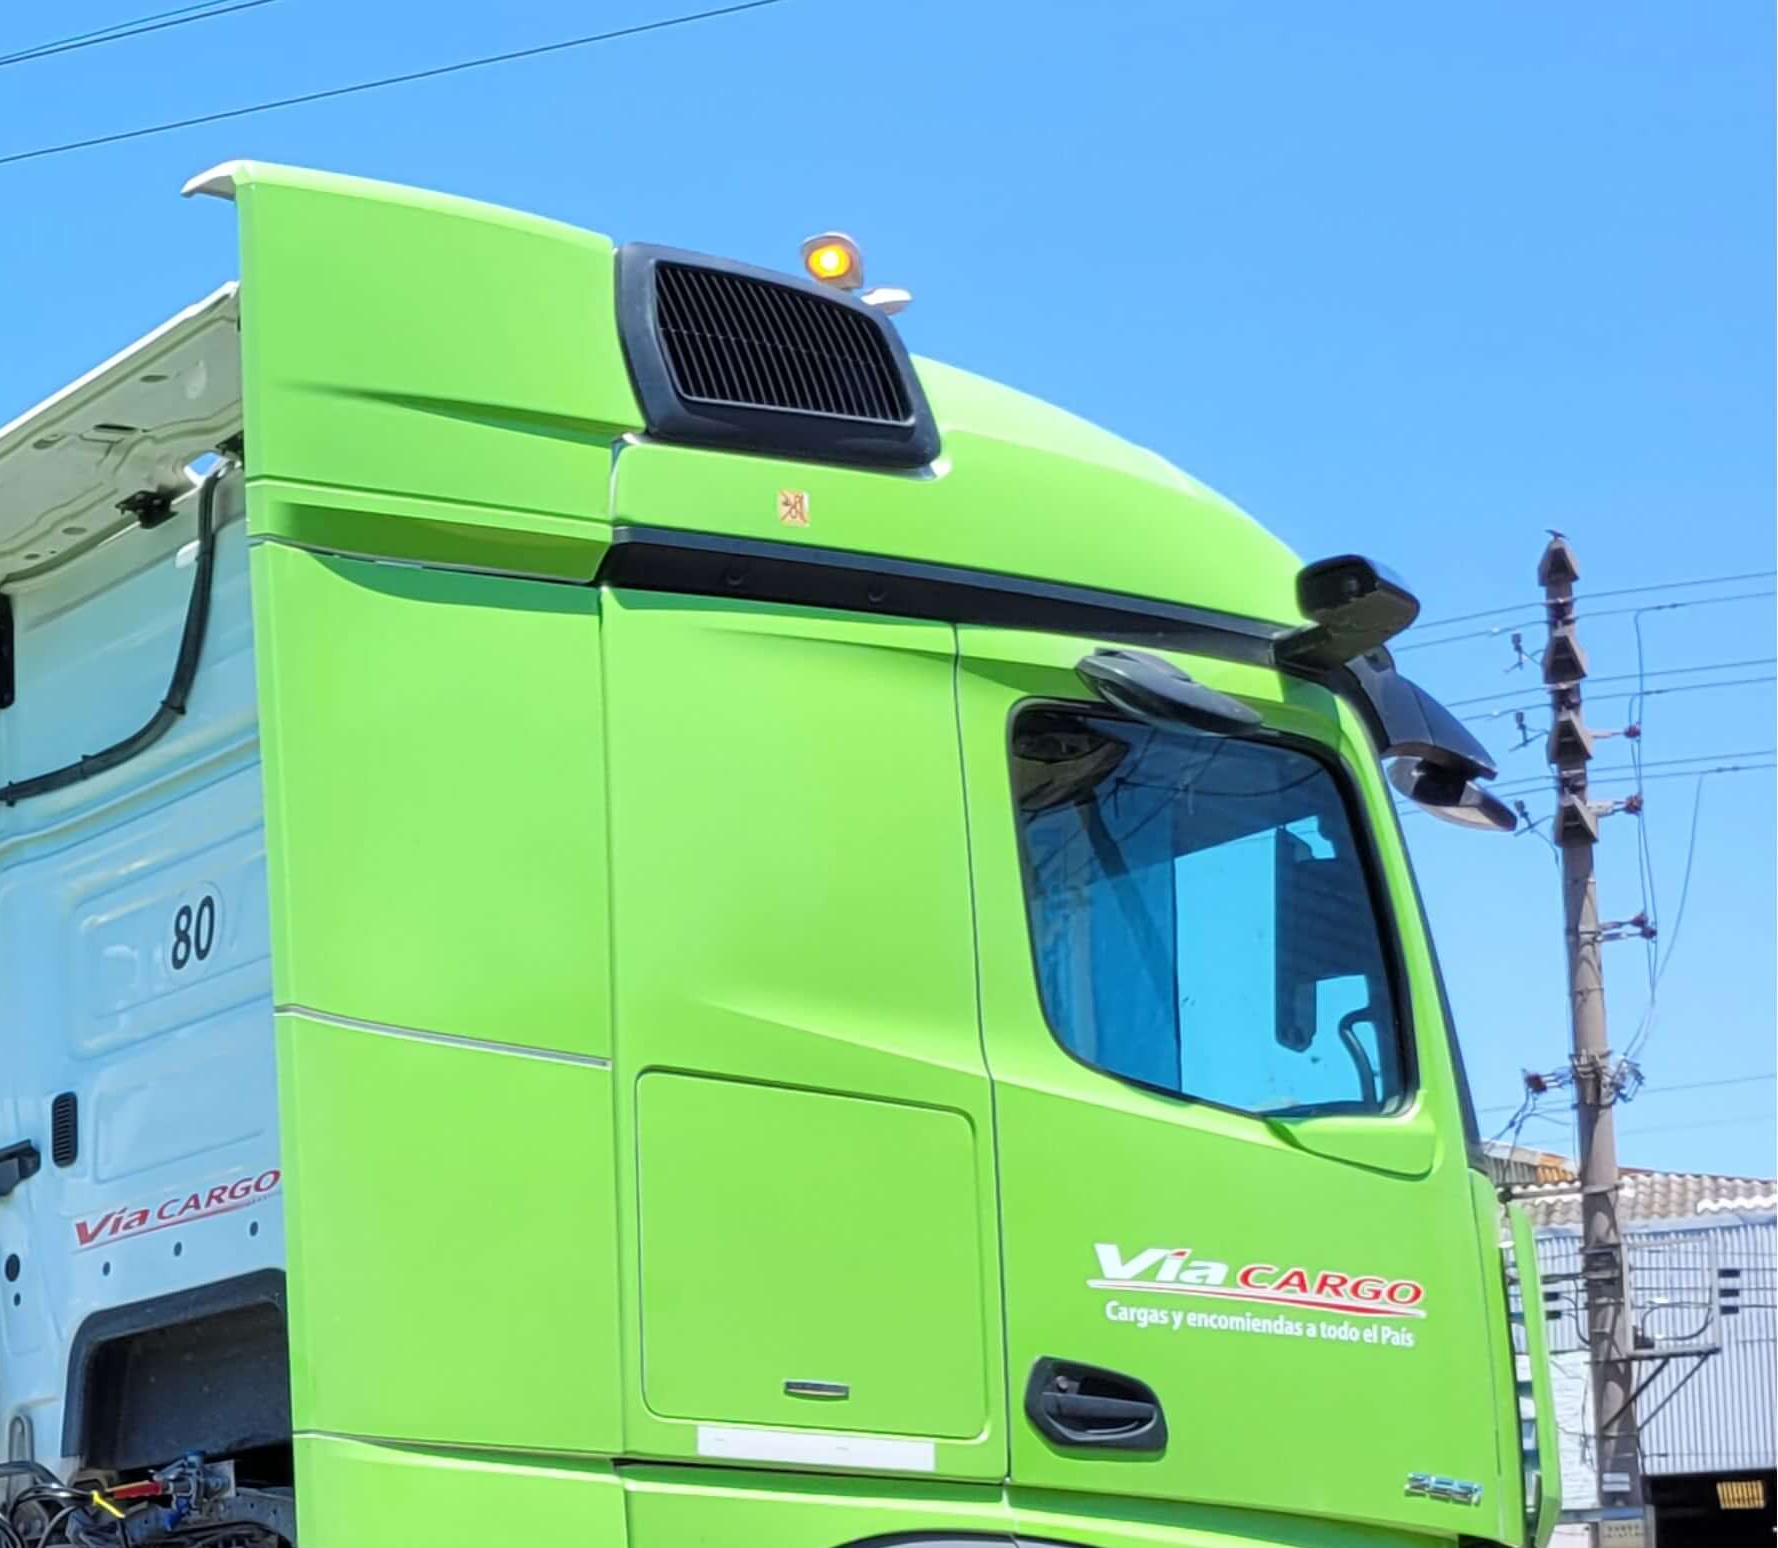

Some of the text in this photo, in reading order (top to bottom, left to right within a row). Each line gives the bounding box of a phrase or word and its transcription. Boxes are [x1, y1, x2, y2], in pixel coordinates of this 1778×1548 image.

[171, 895, 214, 970] 80
[157, 1170, 281, 1220] CARGO
[1237, 1265, 1423, 1307] CARGO
[1105, 1301, 1169, 1328] Cargas
[1171, 1310, 1183, 1330] y
[1187, 1309, 1303, 1338] encomiendas
[1306, 1323, 1317, 1339] a
[1320, 1321, 1359, 1342] todo
[1363, 1324, 1379, 1344] el
